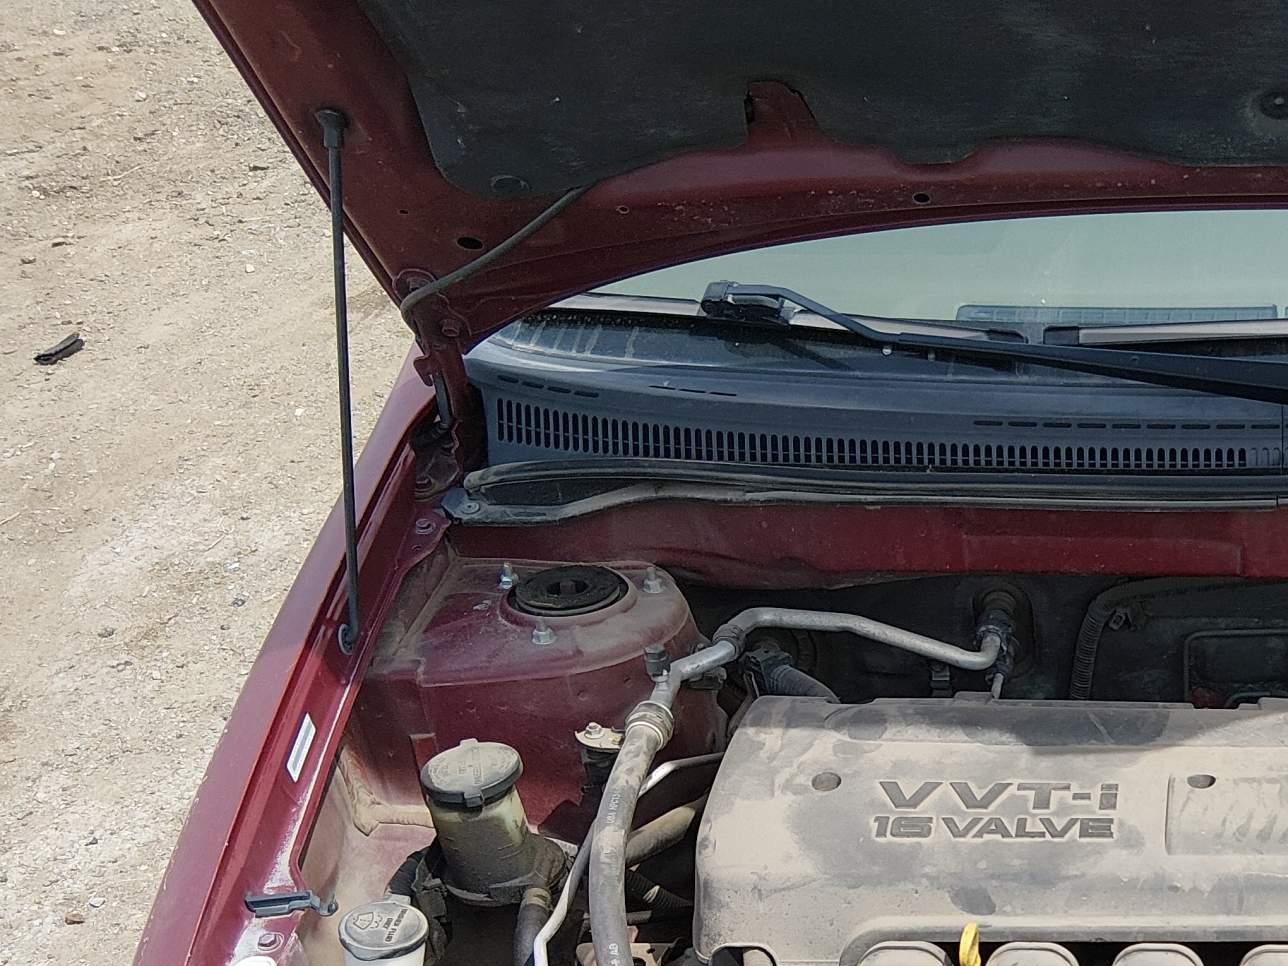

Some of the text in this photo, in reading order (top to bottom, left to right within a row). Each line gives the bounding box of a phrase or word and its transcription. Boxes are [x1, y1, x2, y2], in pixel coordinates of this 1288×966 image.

[879, 781, 1119, 811] VVT-i
[873, 816, 1114, 838] 16 VALVE
